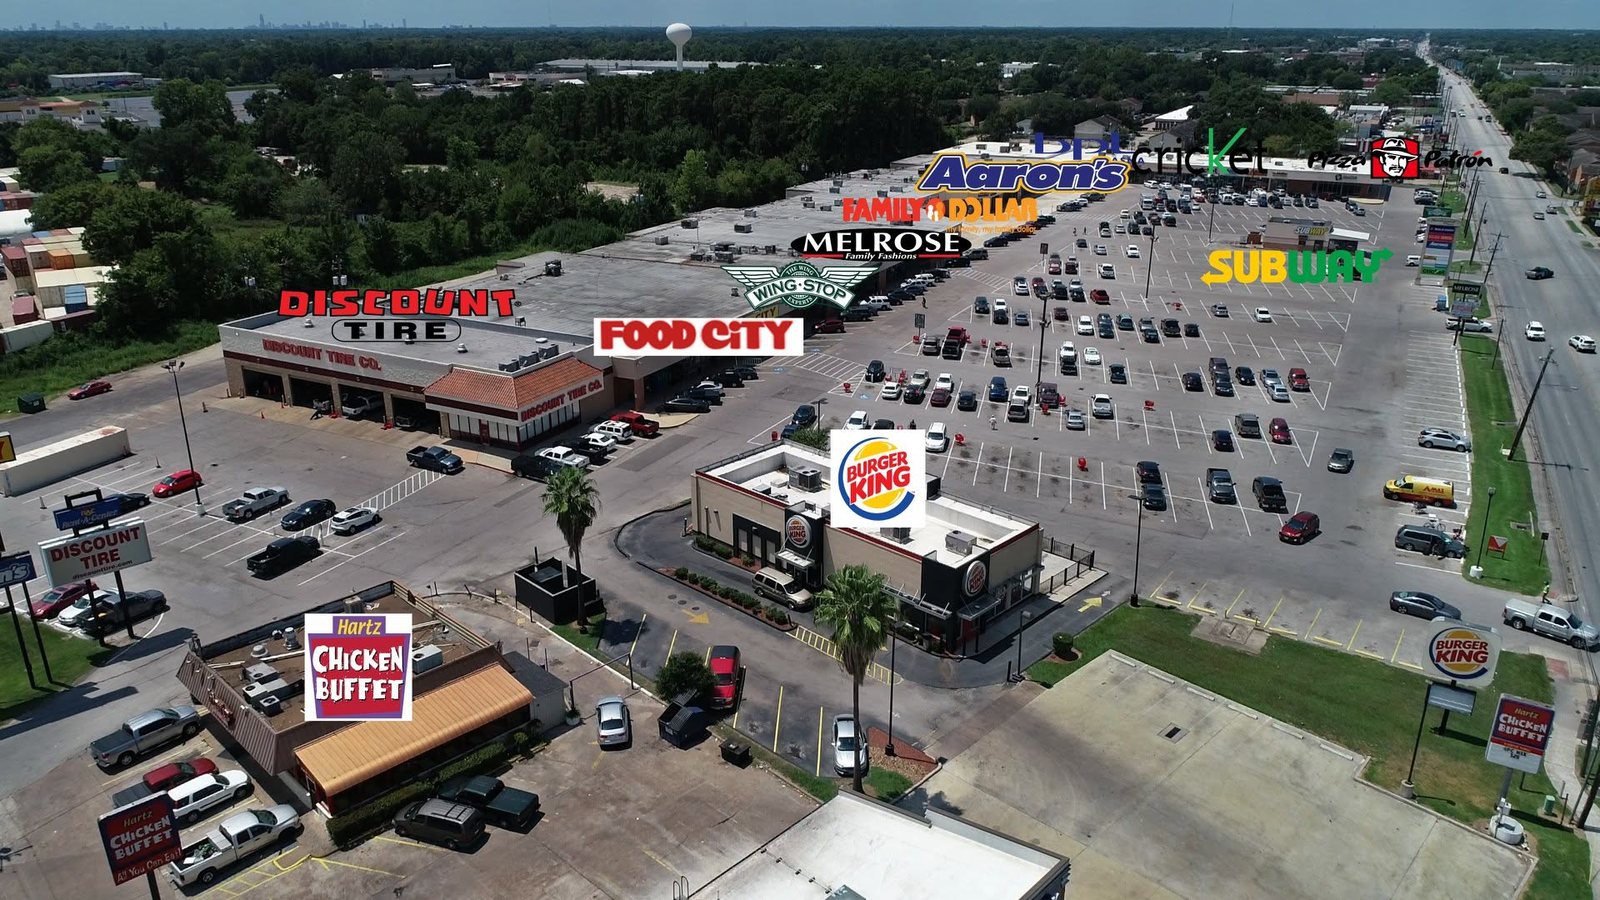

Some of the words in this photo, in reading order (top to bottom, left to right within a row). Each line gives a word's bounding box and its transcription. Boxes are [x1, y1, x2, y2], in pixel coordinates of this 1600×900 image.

[262, 338, 322, 360] DISCOUNT
[326, 350, 356, 366] TIRE
[359, 356, 381, 371] CO.
[521, 394, 565, 422] DISCOUNT
[567, 385, 587, 401] TIRE
[588, 380, 602, 392] CO.
[50, 526, 141, 562] DISCOUNT
[790, 530, 806, 538] KING
[80, 548, 120, 570] TIRE
[1435, 640, 1489, 651] BURGER
[1435, 650, 1489, 664] KING
[1514, 707, 1540, 719] Hartz
[1498, 713, 1547, 734] CHICKEN
[1498, 723, 1546, 742] BUFFET
[123, 811, 153, 828] Hartz
[110, 815, 172, 849] CHICKEN
[114, 829, 172, 860] BUFFET
[129, 866, 145, 877] You
